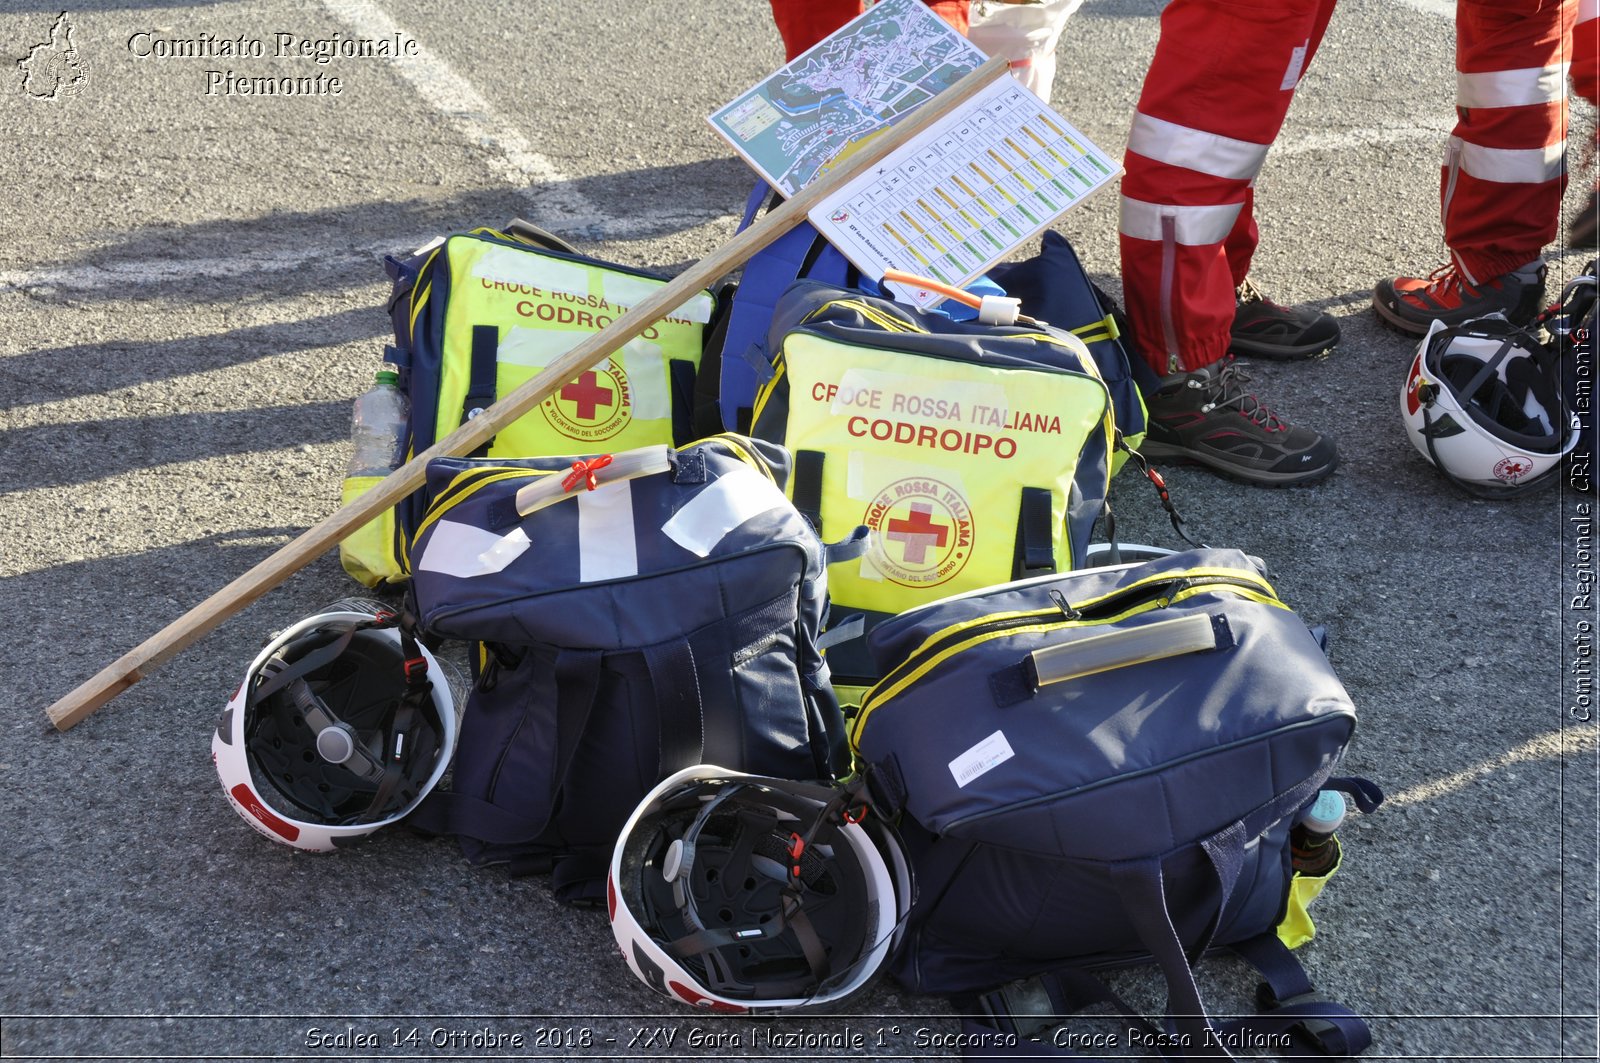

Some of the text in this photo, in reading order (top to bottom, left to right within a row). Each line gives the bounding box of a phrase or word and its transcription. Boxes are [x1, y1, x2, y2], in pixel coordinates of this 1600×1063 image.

[516, 300, 659, 339] CODROO
[607, 362, 631, 407] TALIANA
[549, 408, 580, 435] VOLONTARIO
[594, 417, 623, 437] SOCCORSO
[811, 381, 1062, 435] CROCE ROSSA ITALIANA
[847, 415, 1018, 460] CODROIPO
[894, 481, 938, 497] ROSSA
[942, 491, 970, 548] ITALIANA
